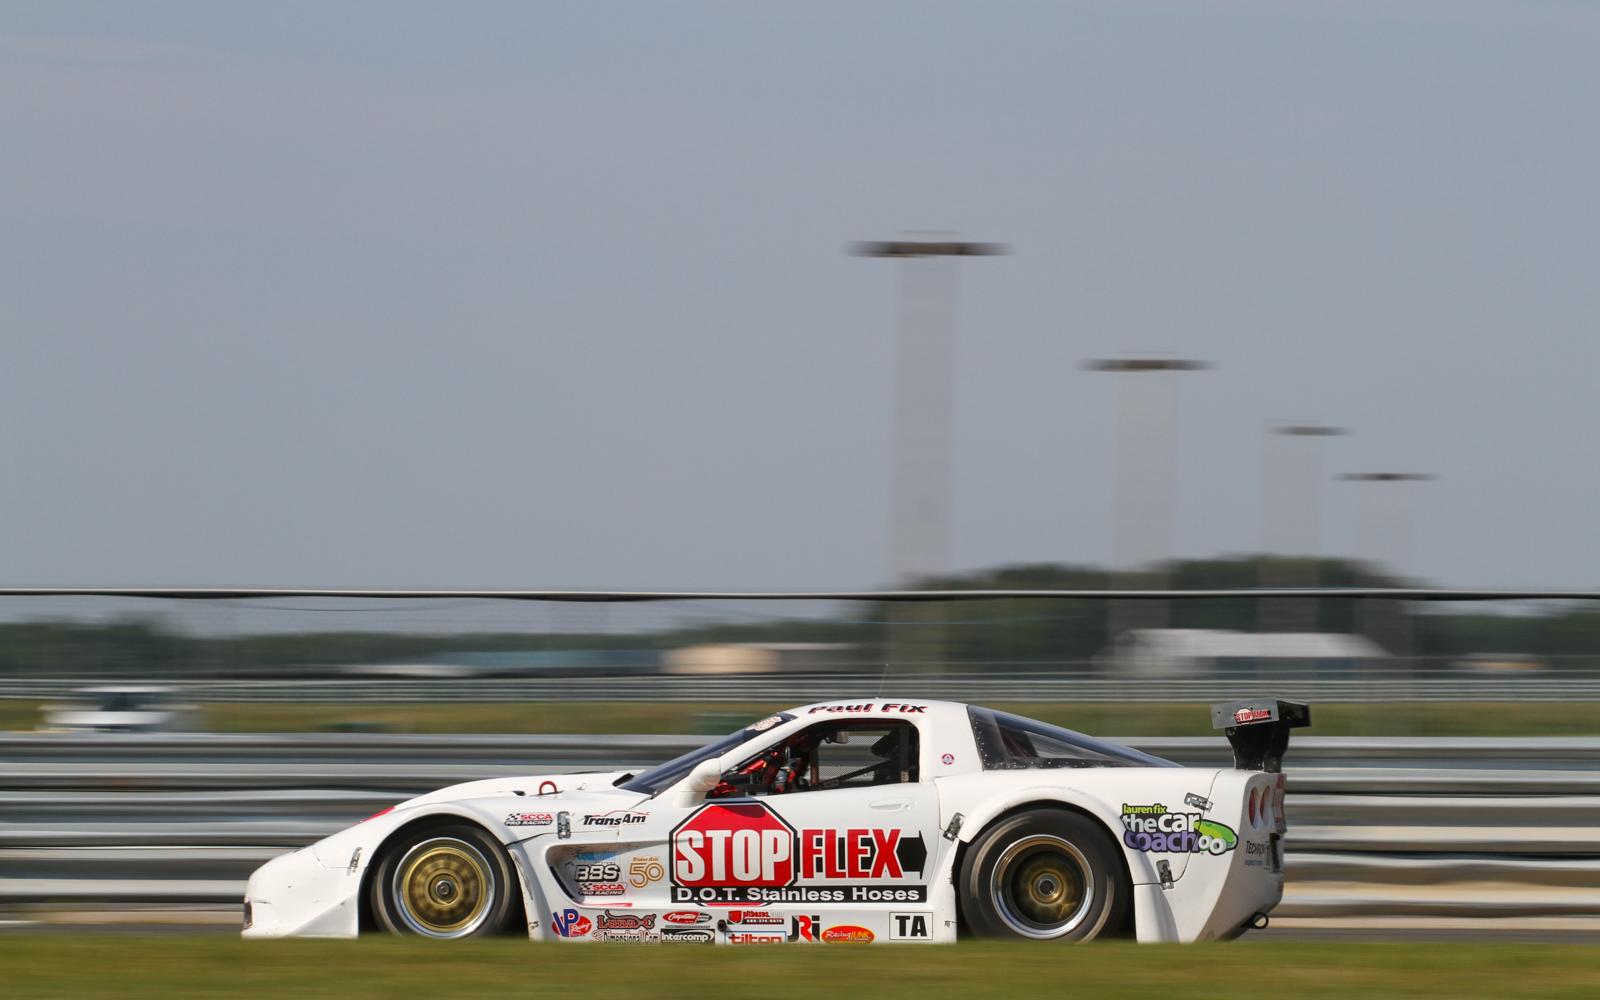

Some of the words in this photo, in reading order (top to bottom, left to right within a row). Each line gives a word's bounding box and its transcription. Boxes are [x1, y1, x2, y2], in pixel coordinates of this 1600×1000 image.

[808, 703, 873, 714] Paul
[881, 703, 928, 714] Fix
[1123, 804, 1152, 814] lauren
[1153, 804, 1166, 814] fix
[1122, 814, 1157, 833] the
[1158, 814, 1200, 833] car
[575, 864, 620, 882] BBS
[629, 863, 664, 888] 50
[677, 887, 740, 901] D.O.T.
[747, 887, 845, 901] Stainless
[852, 887, 920, 901] Hoses
[553, 909, 579, 937] VP
[895, 916, 927, 936] TA
[661, 931, 709, 943] Intercomp
[728, 934, 782, 944] tilton
